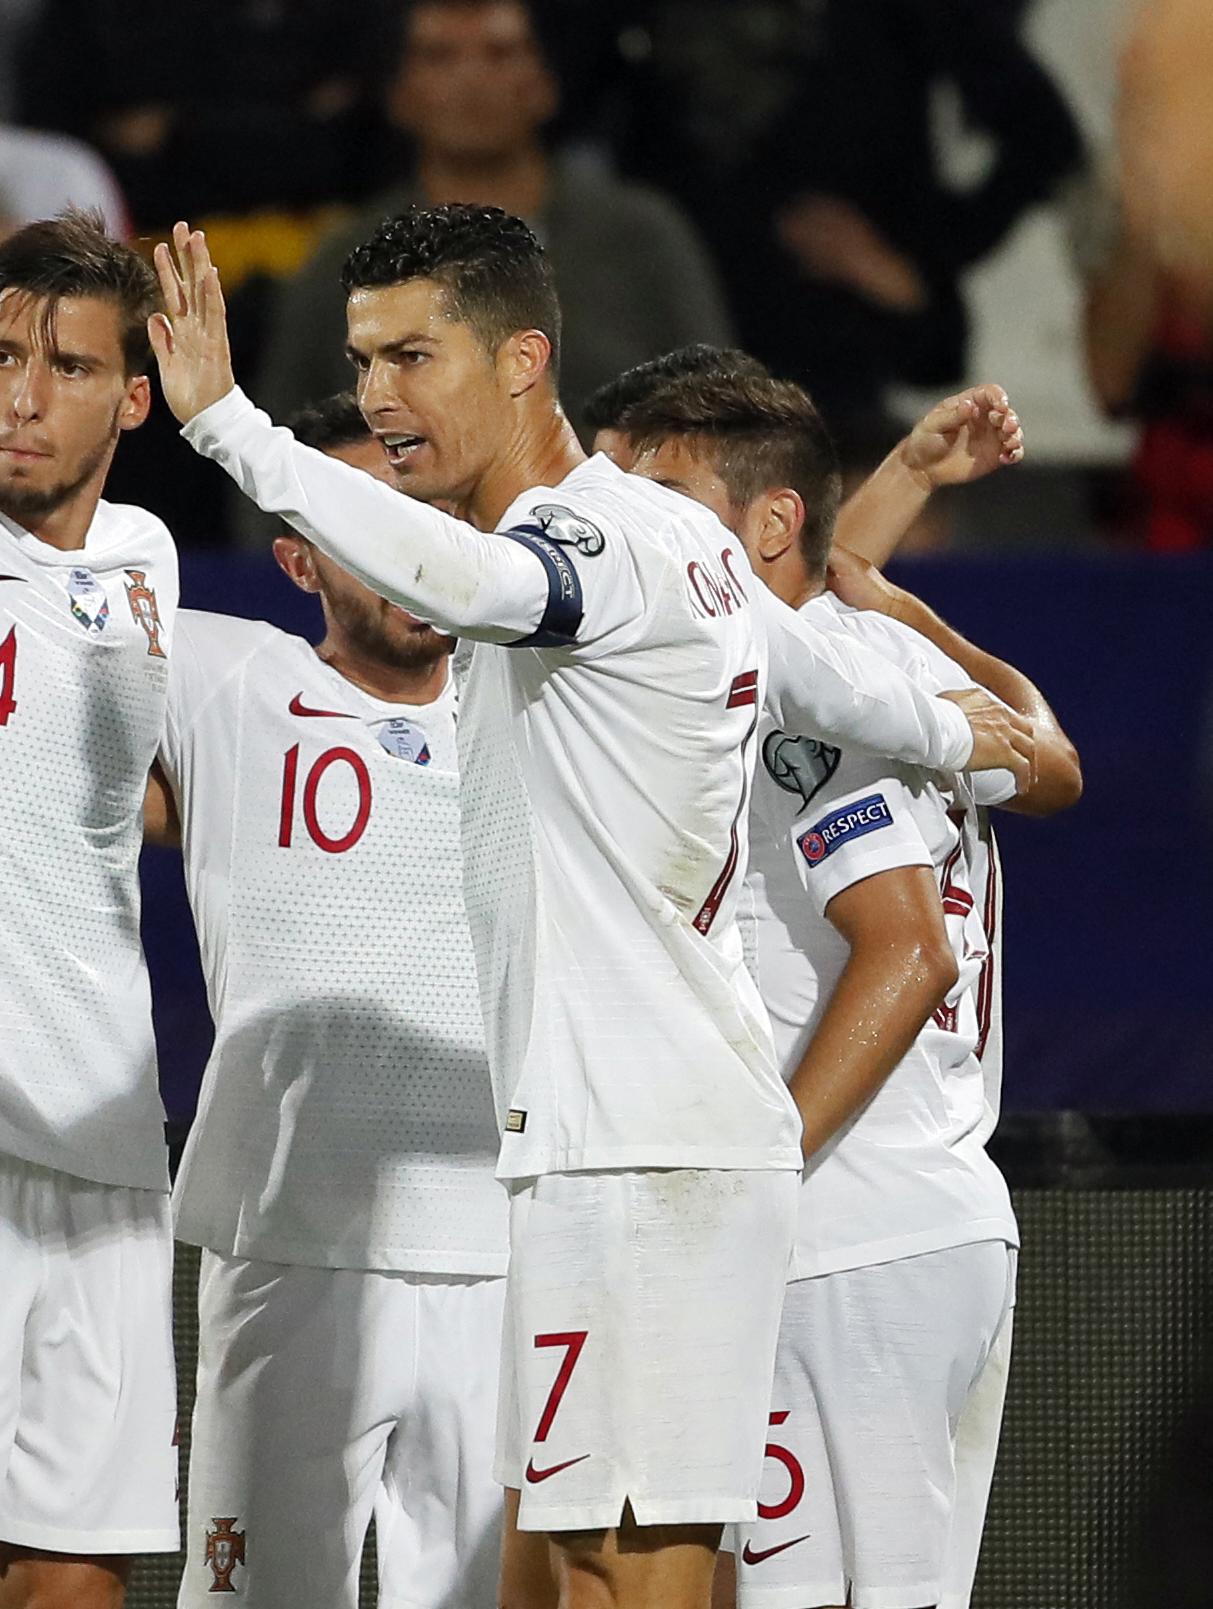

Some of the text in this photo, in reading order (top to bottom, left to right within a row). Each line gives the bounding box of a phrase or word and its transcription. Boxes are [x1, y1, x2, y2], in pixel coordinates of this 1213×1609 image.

[278, 741, 372, 854] 10
[821, 802, 887, 844] RESPECT
[533, 1330, 589, 1443] 7
